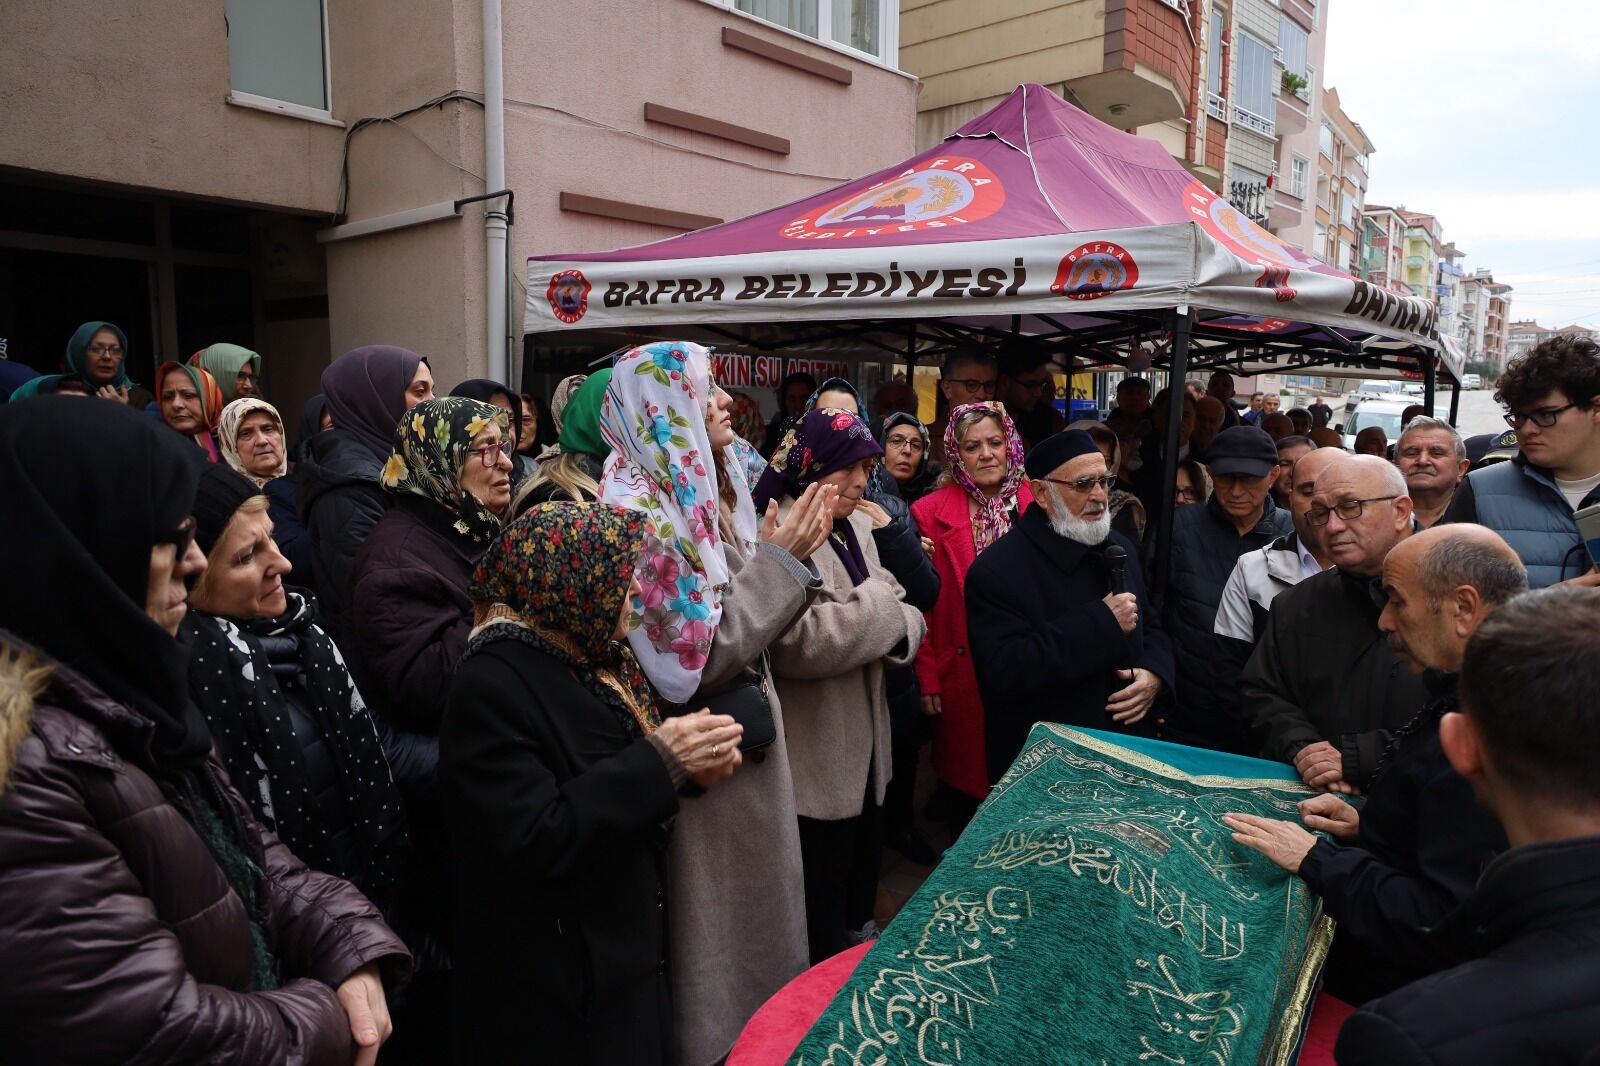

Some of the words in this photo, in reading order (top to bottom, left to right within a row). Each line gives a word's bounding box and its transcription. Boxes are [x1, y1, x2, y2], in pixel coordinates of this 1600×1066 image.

[868, 159, 992, 190] FRA
[1068, 244, 1124, 262] BAFRA
[603, 277, 725, 308] BAFRA
[735, 257, 1027, 301] BELEDİYESİ
[711, 351, 751, 389] KİN
[755, 354, 783, 389] SU
